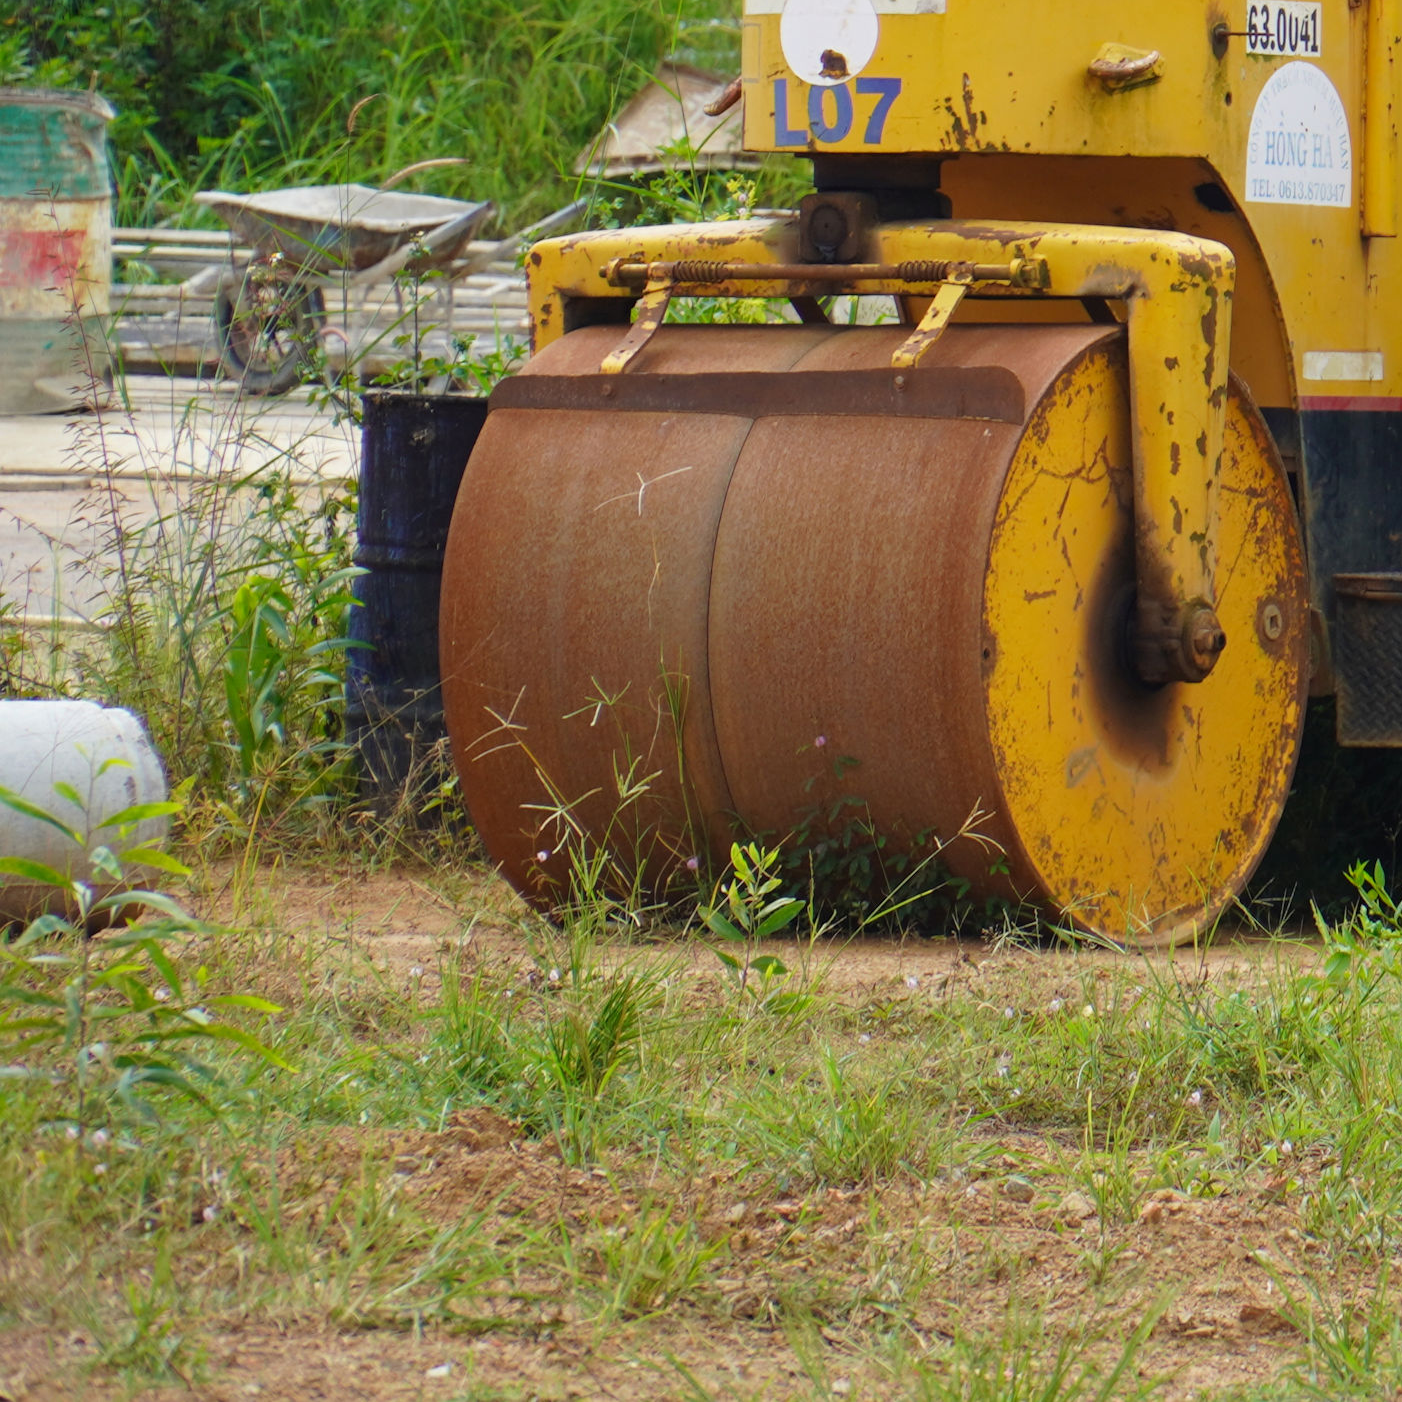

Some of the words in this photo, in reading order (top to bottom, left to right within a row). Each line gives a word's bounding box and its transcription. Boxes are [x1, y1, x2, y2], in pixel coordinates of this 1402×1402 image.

[1249, 4, 1319, 53] 63.0041
[774, 77, 902, 147] L07
[1252, 179, 1275, 198] TEL:
[1279, 180, 1346, 203] 0613.870347
